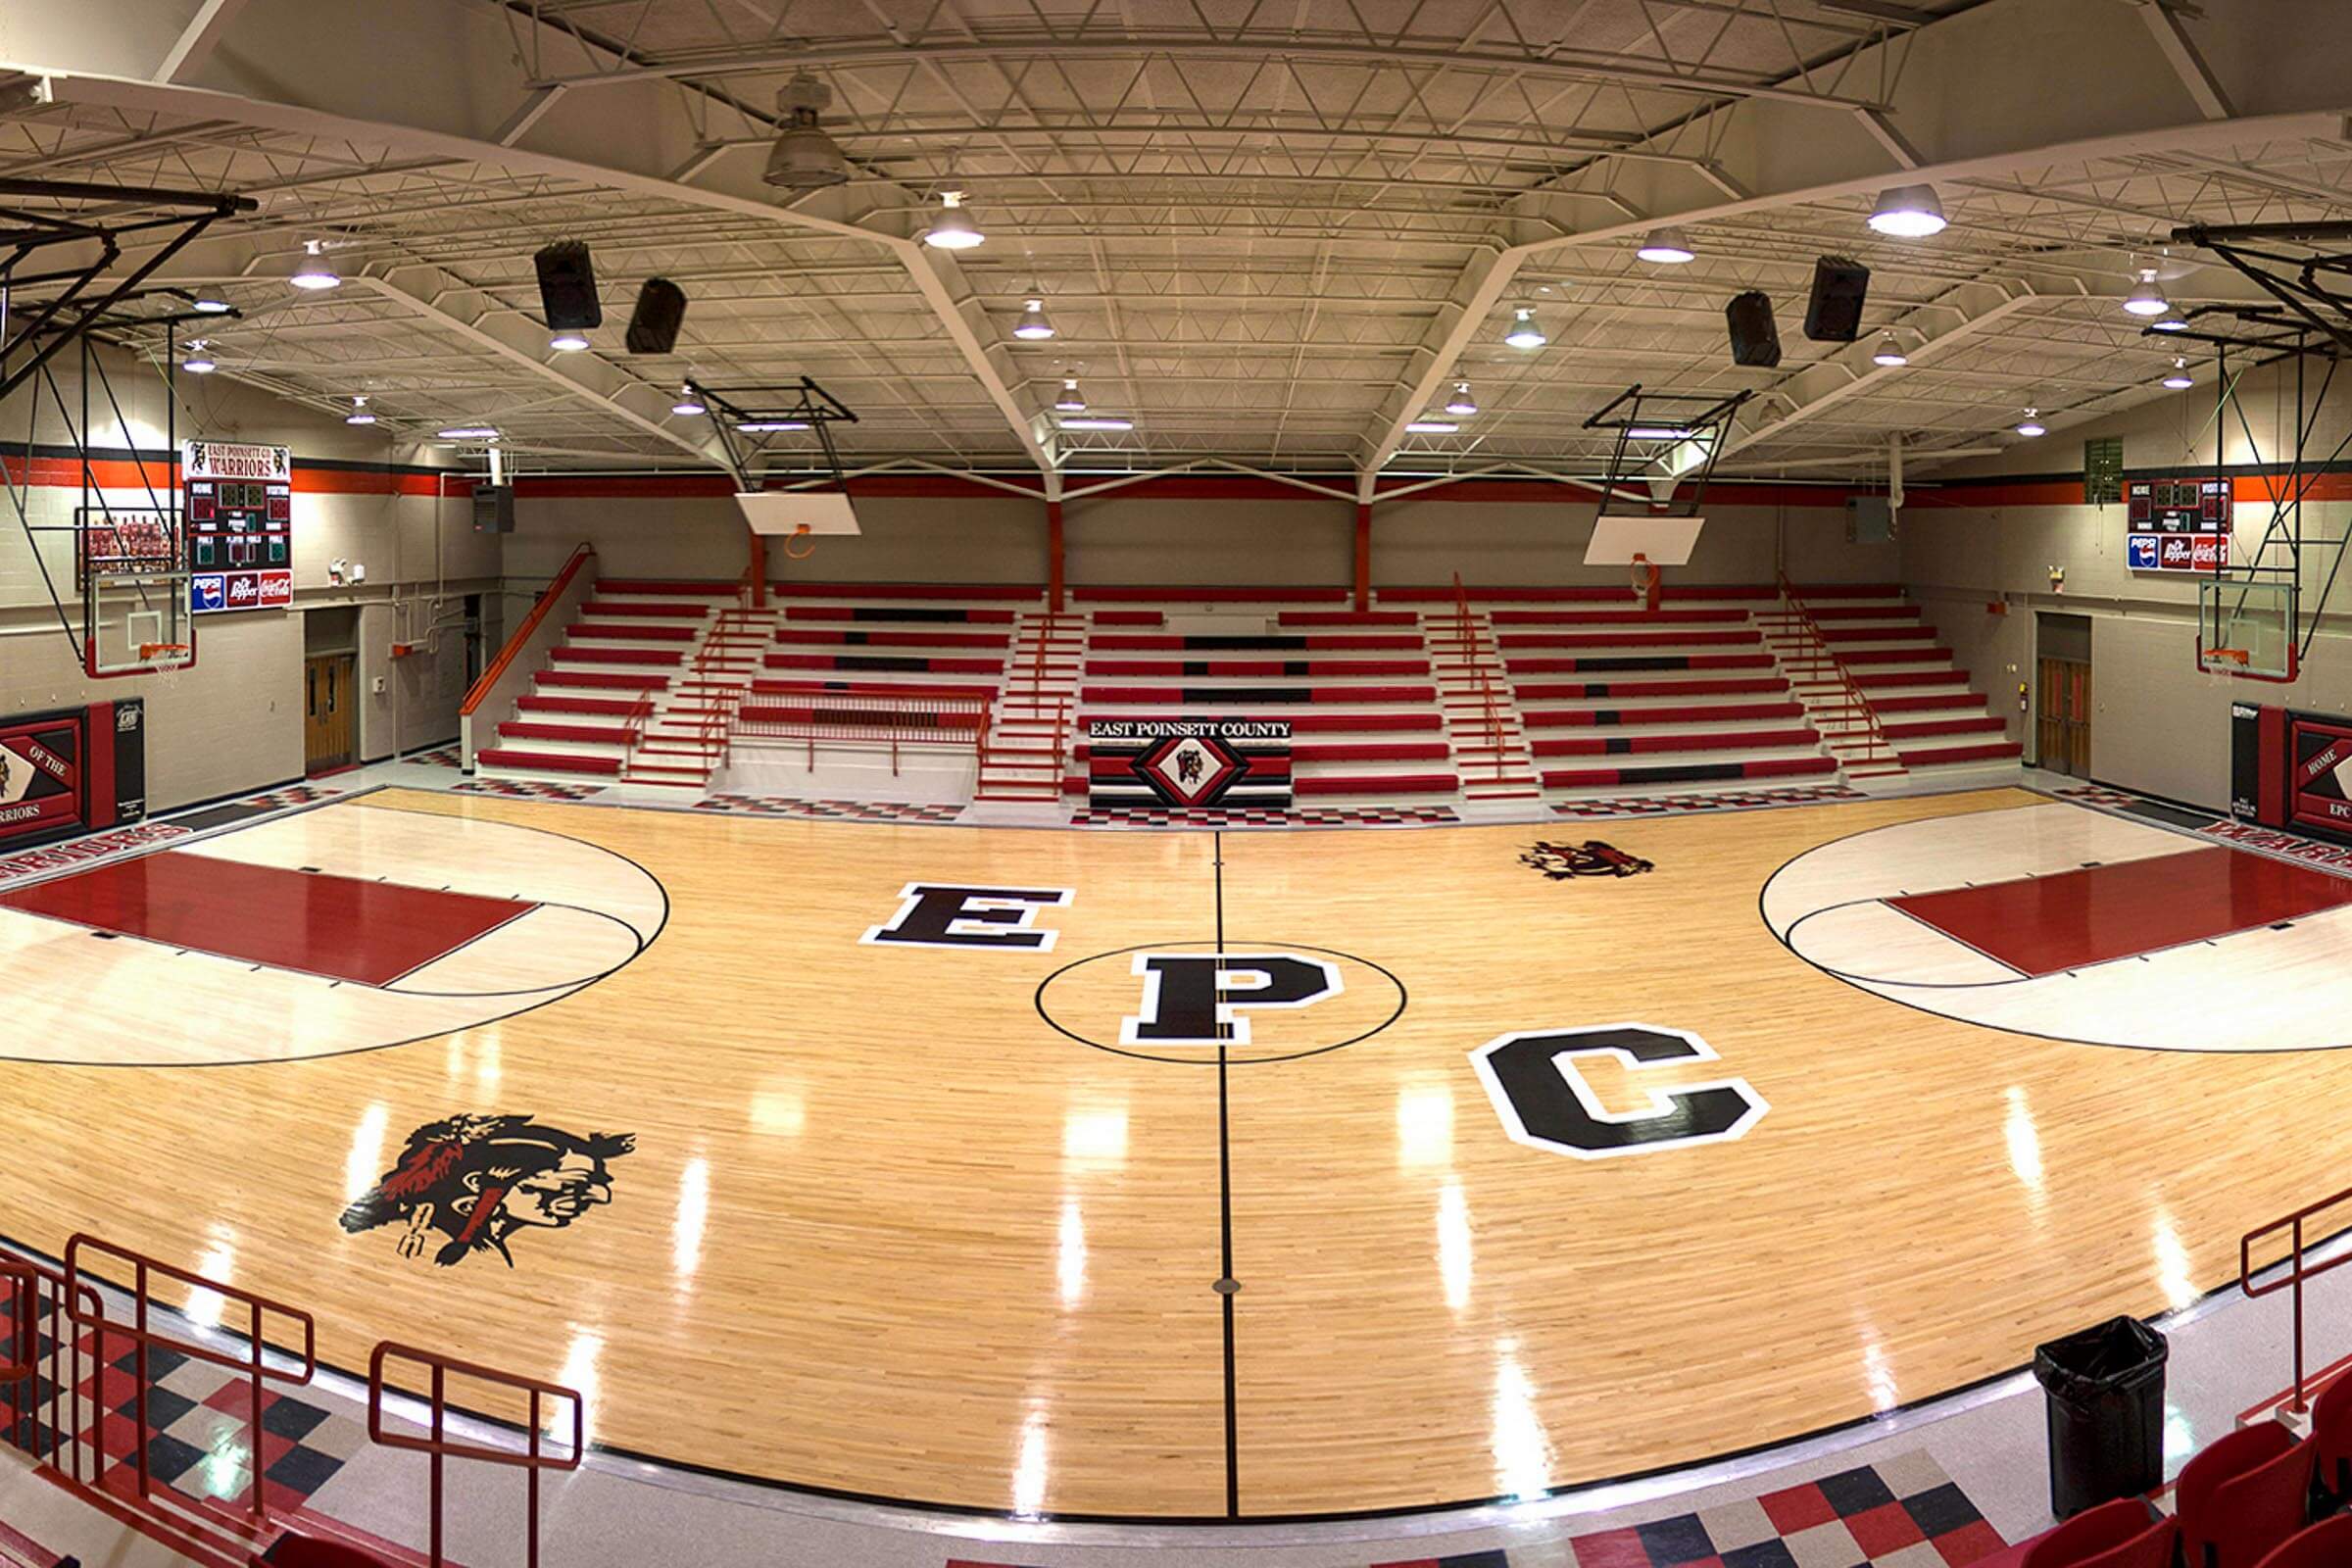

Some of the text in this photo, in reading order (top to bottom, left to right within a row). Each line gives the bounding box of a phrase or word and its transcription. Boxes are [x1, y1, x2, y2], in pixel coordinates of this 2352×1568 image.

[208, 445, 225, 457] EAST
[227, 446, 260, 458] POINSETT
[209, 457, 272, 476] WARRIORS
[2132, 538, 2156, 548] PEPSI
[193, 577, 221, 589] PEPSI
[1090, 721, 1291, 736] EAST POINSETT COUNTY
[29, 746, 67, 776] OF THE
[2308, 748, 2337, 775] HOME
[2329, 803, 2352, 817] EPC
[857, 882, 1772, 1160] E P C
